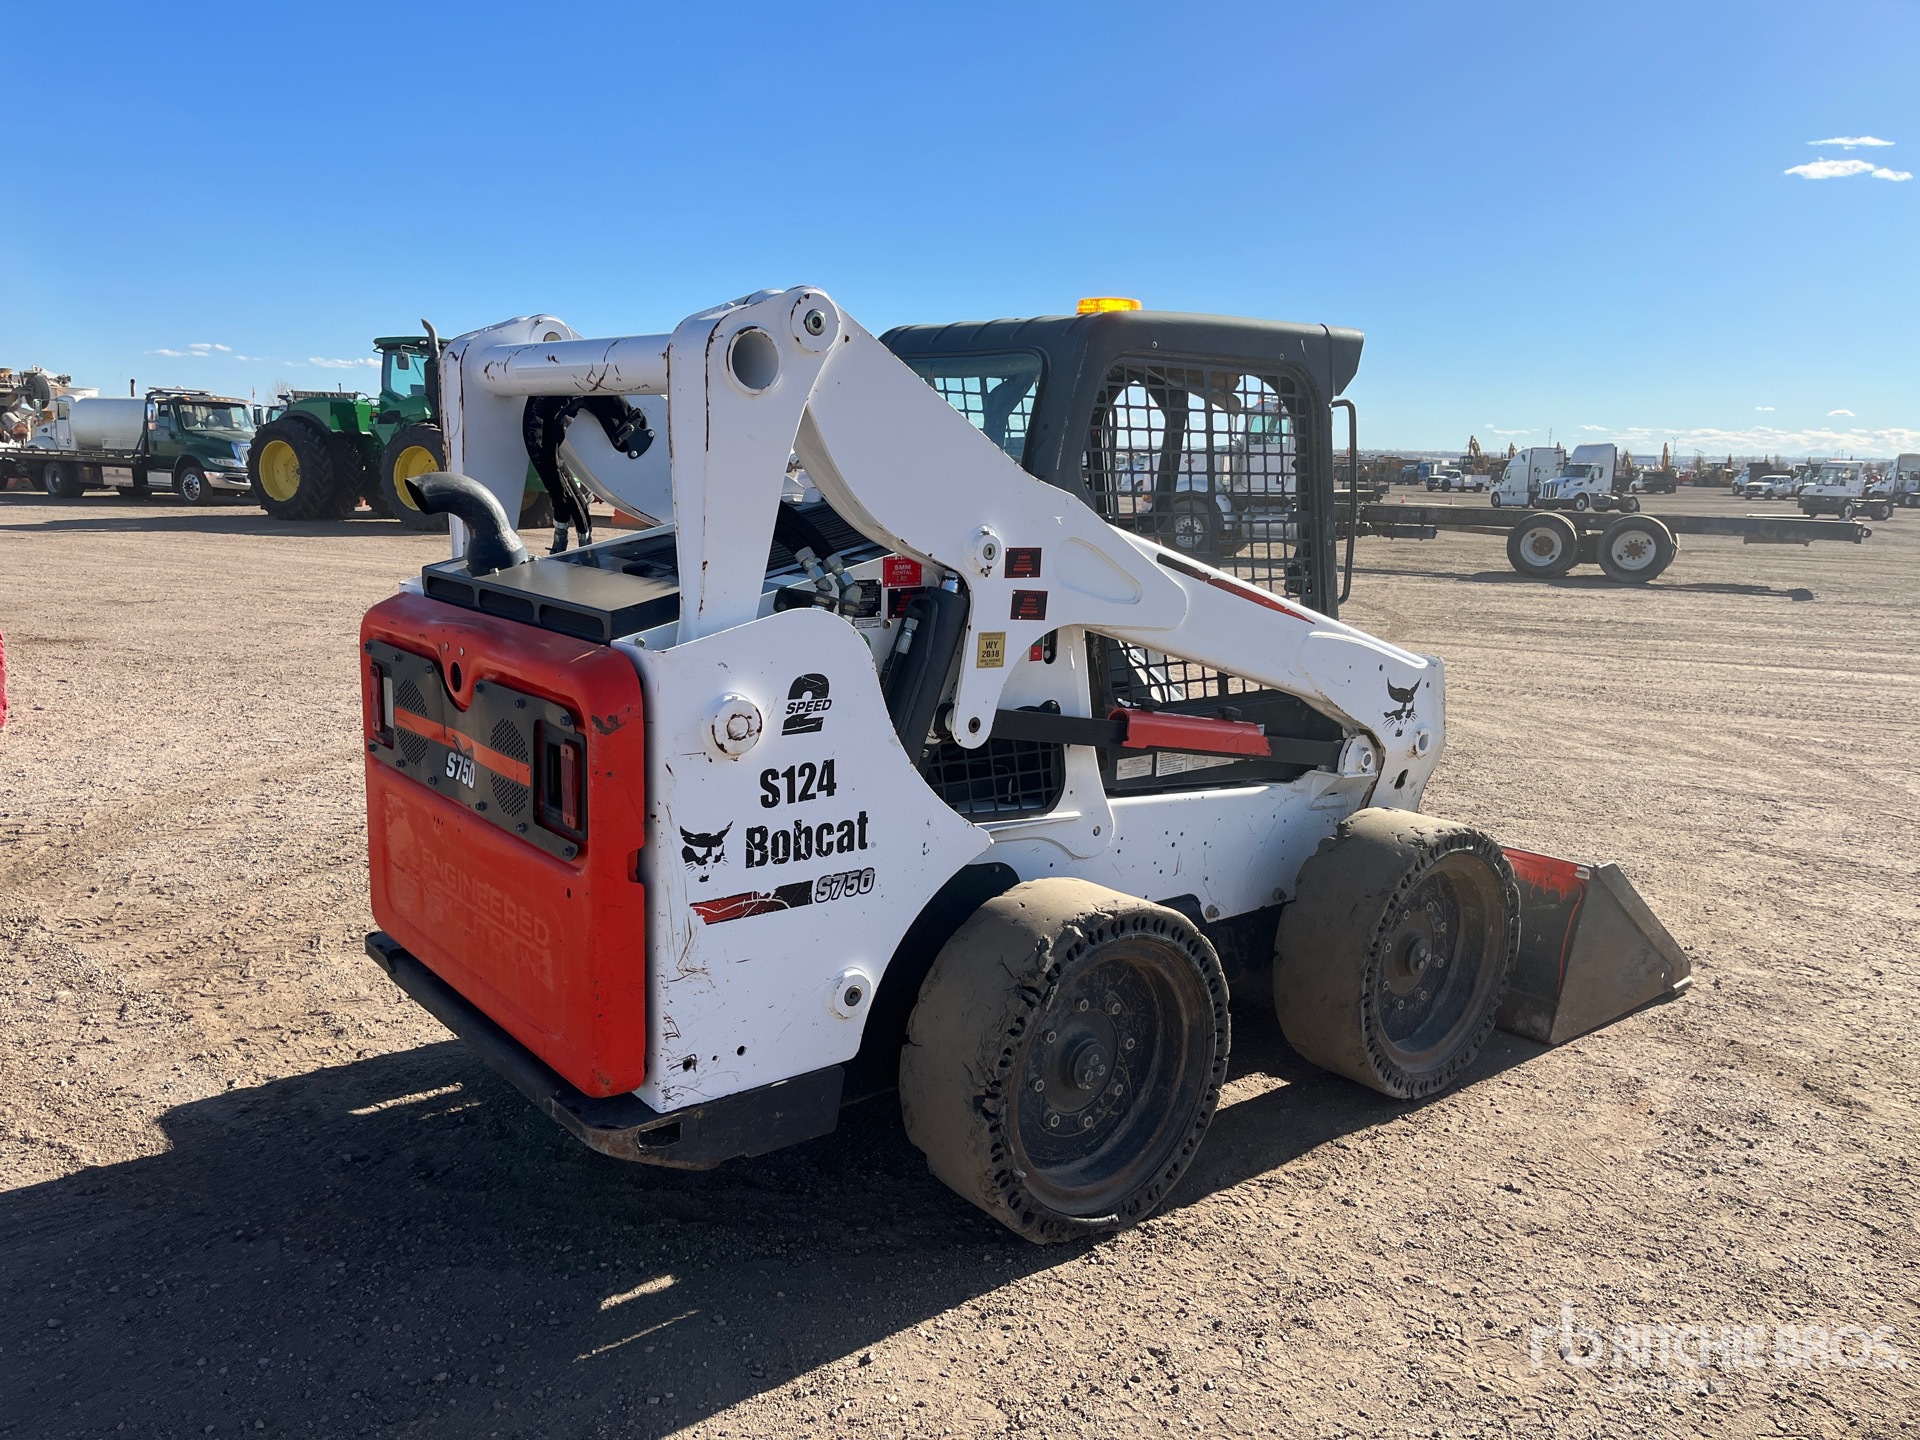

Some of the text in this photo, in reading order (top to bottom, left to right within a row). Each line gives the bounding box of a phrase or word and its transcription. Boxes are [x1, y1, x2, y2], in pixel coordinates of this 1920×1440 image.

[981, 650, 1000, 659] 2018
[985, 641, 999, 650] WY
[785, 699, 833, 715] SPEED
[445, 752, 476, 789] S750
[759, 759, 837, 809] S124
[745, 811, 869, 869] Bobcat
[815, 867, 876, 904] S750
